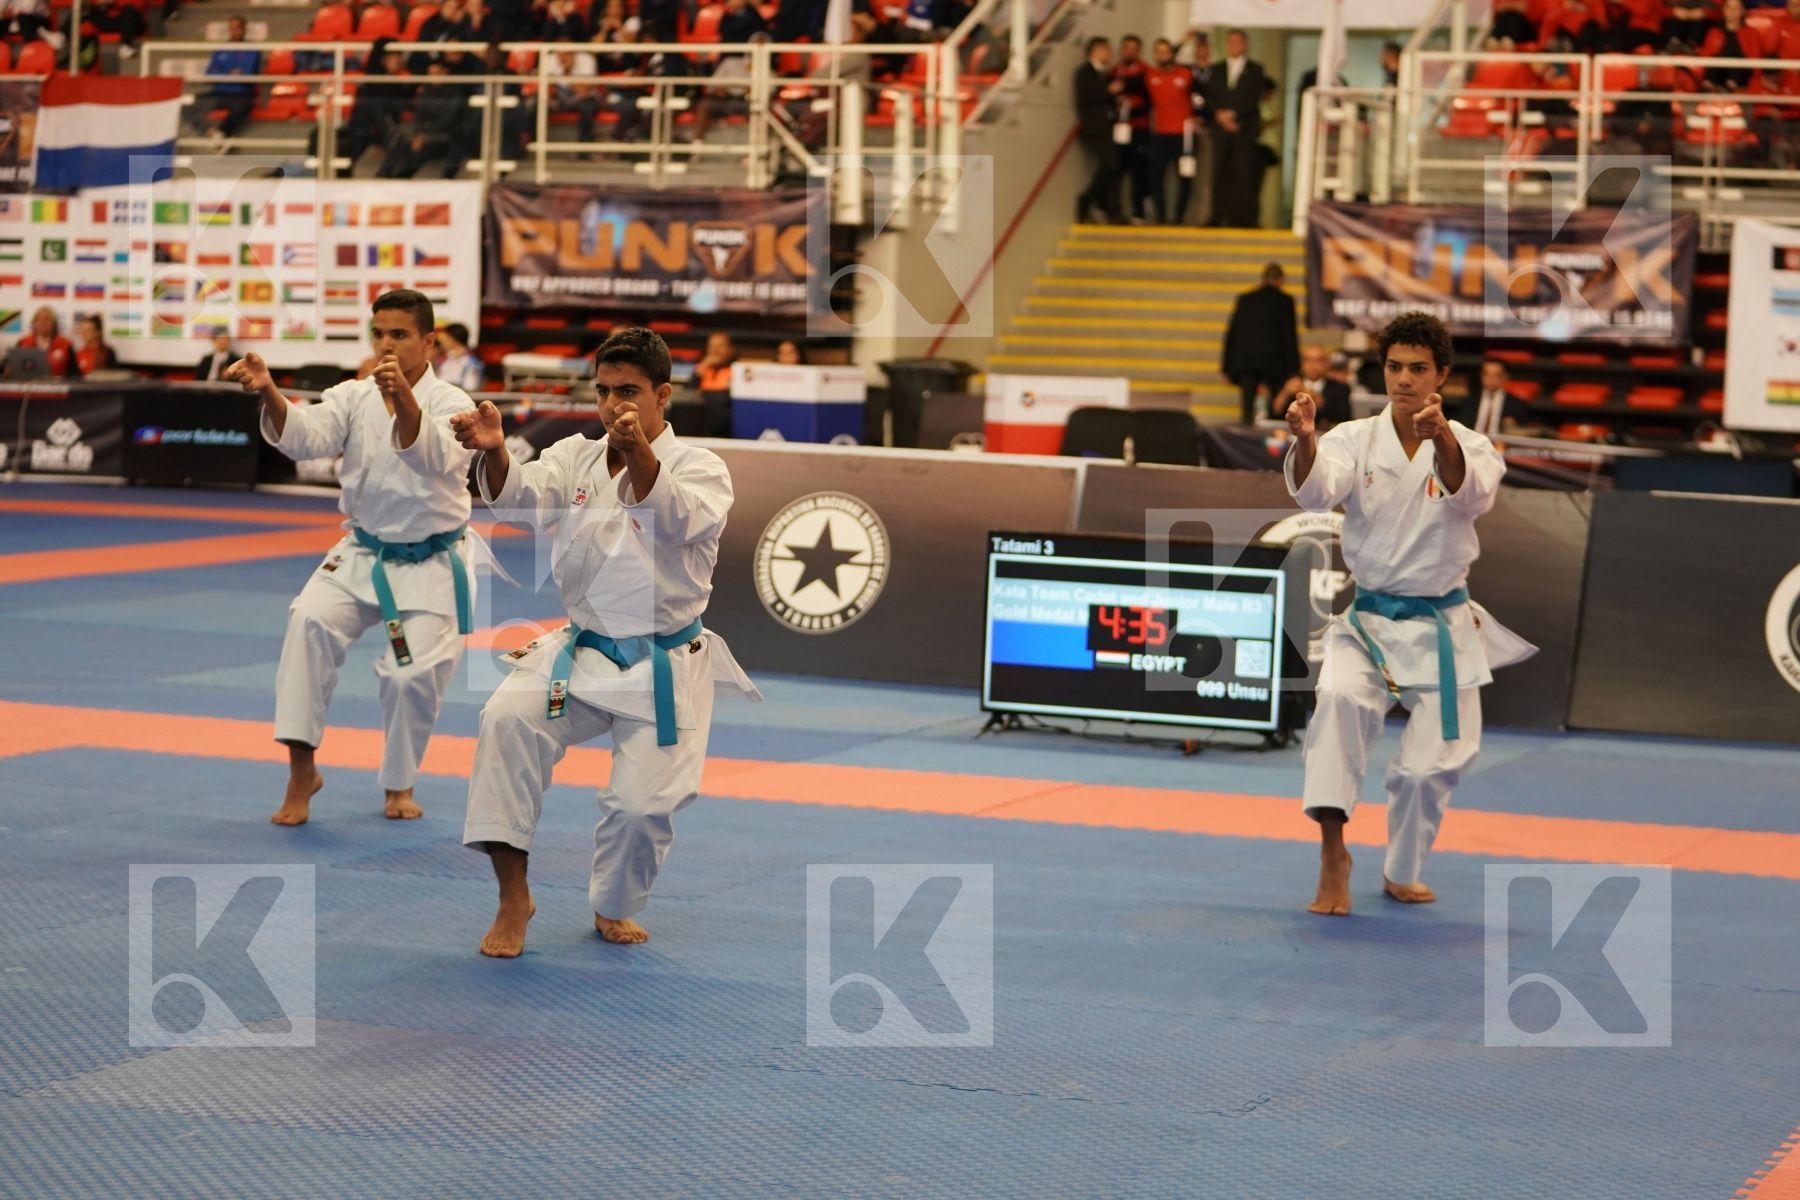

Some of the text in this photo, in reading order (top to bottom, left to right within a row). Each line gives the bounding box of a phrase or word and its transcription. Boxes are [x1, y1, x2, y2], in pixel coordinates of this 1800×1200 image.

[991, 536, 1055, 556] Tatami 3
[1097, 604, 1168, 646] 4:35
[1131, 653, 1187, 673] EGYPT
[1227, 682, 1269, 702] Unsu
